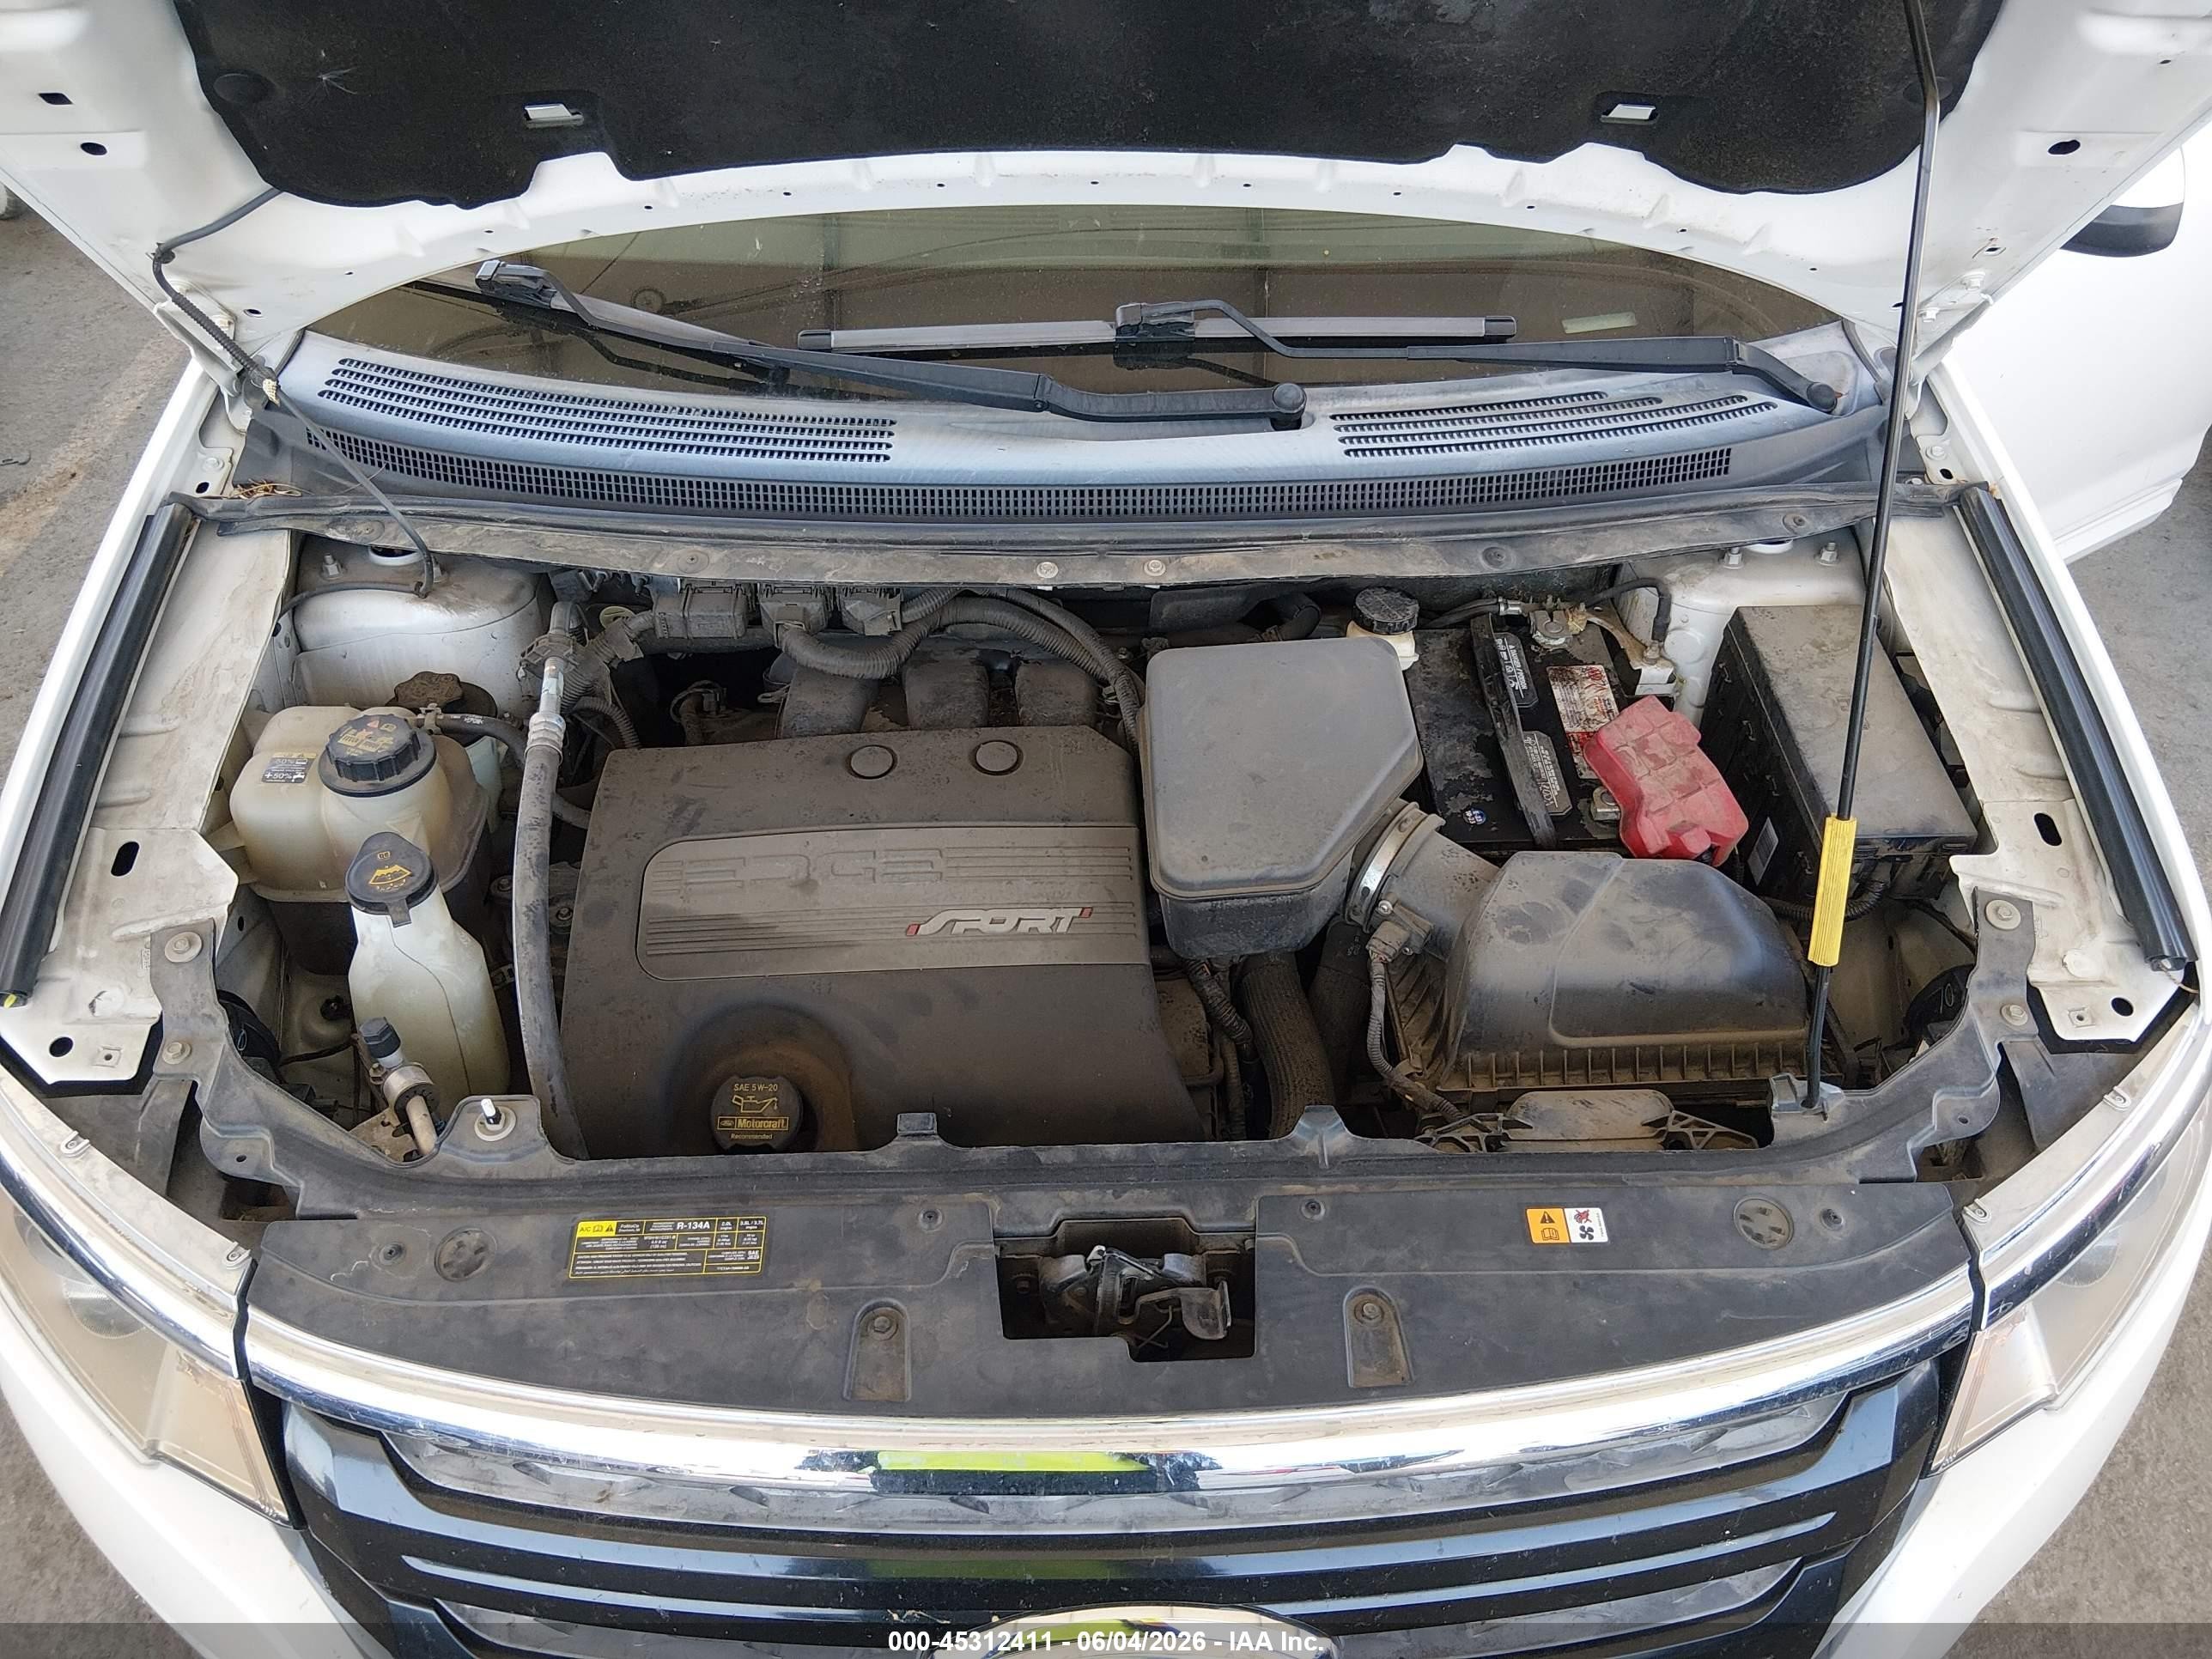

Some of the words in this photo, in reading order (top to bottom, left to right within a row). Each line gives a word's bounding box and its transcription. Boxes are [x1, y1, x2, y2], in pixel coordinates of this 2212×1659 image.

[912, 907, 1084, 936] SPORT
[733, 1083, 750, 1091] SAE
[738, 1118, 787, 1129] Motorcraft
[676, 1221, 711, 1231] R-134A
